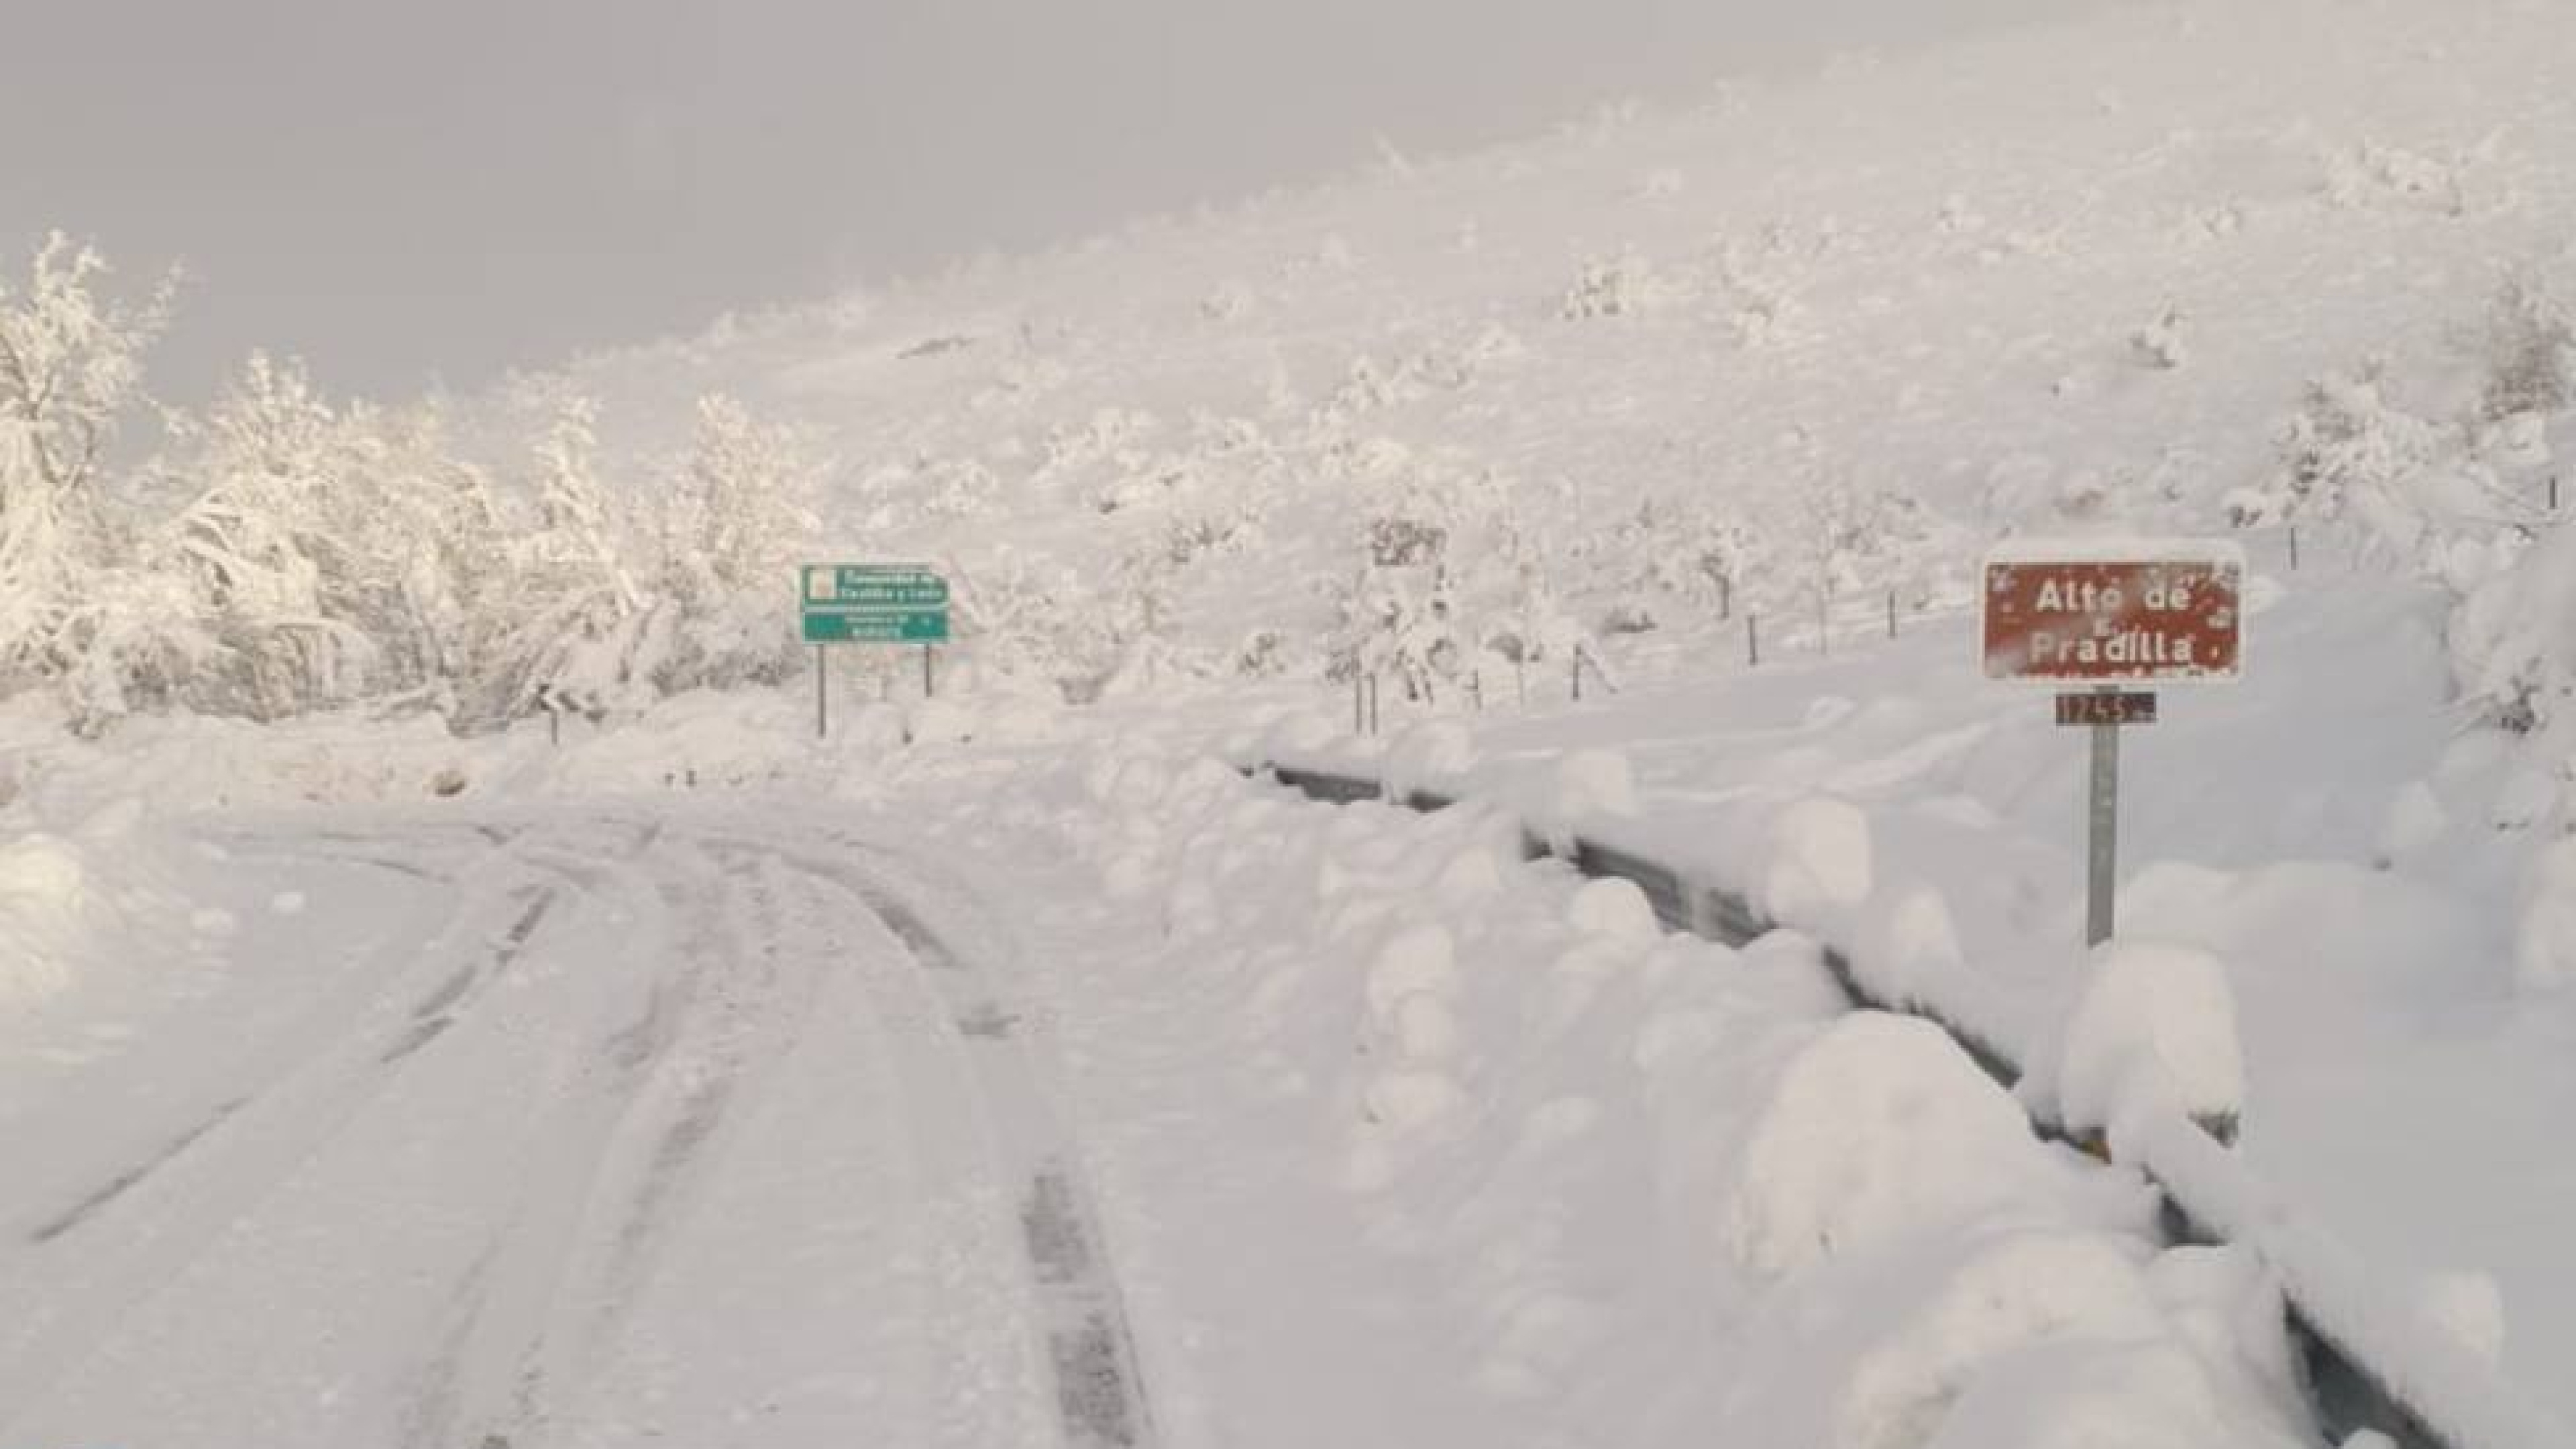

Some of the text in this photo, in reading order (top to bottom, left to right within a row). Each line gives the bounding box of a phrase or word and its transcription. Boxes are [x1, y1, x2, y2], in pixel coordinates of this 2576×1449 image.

[2035, 576, 2191, 612] Alto de
[2030, 629, 2191, 662] Pradilla
